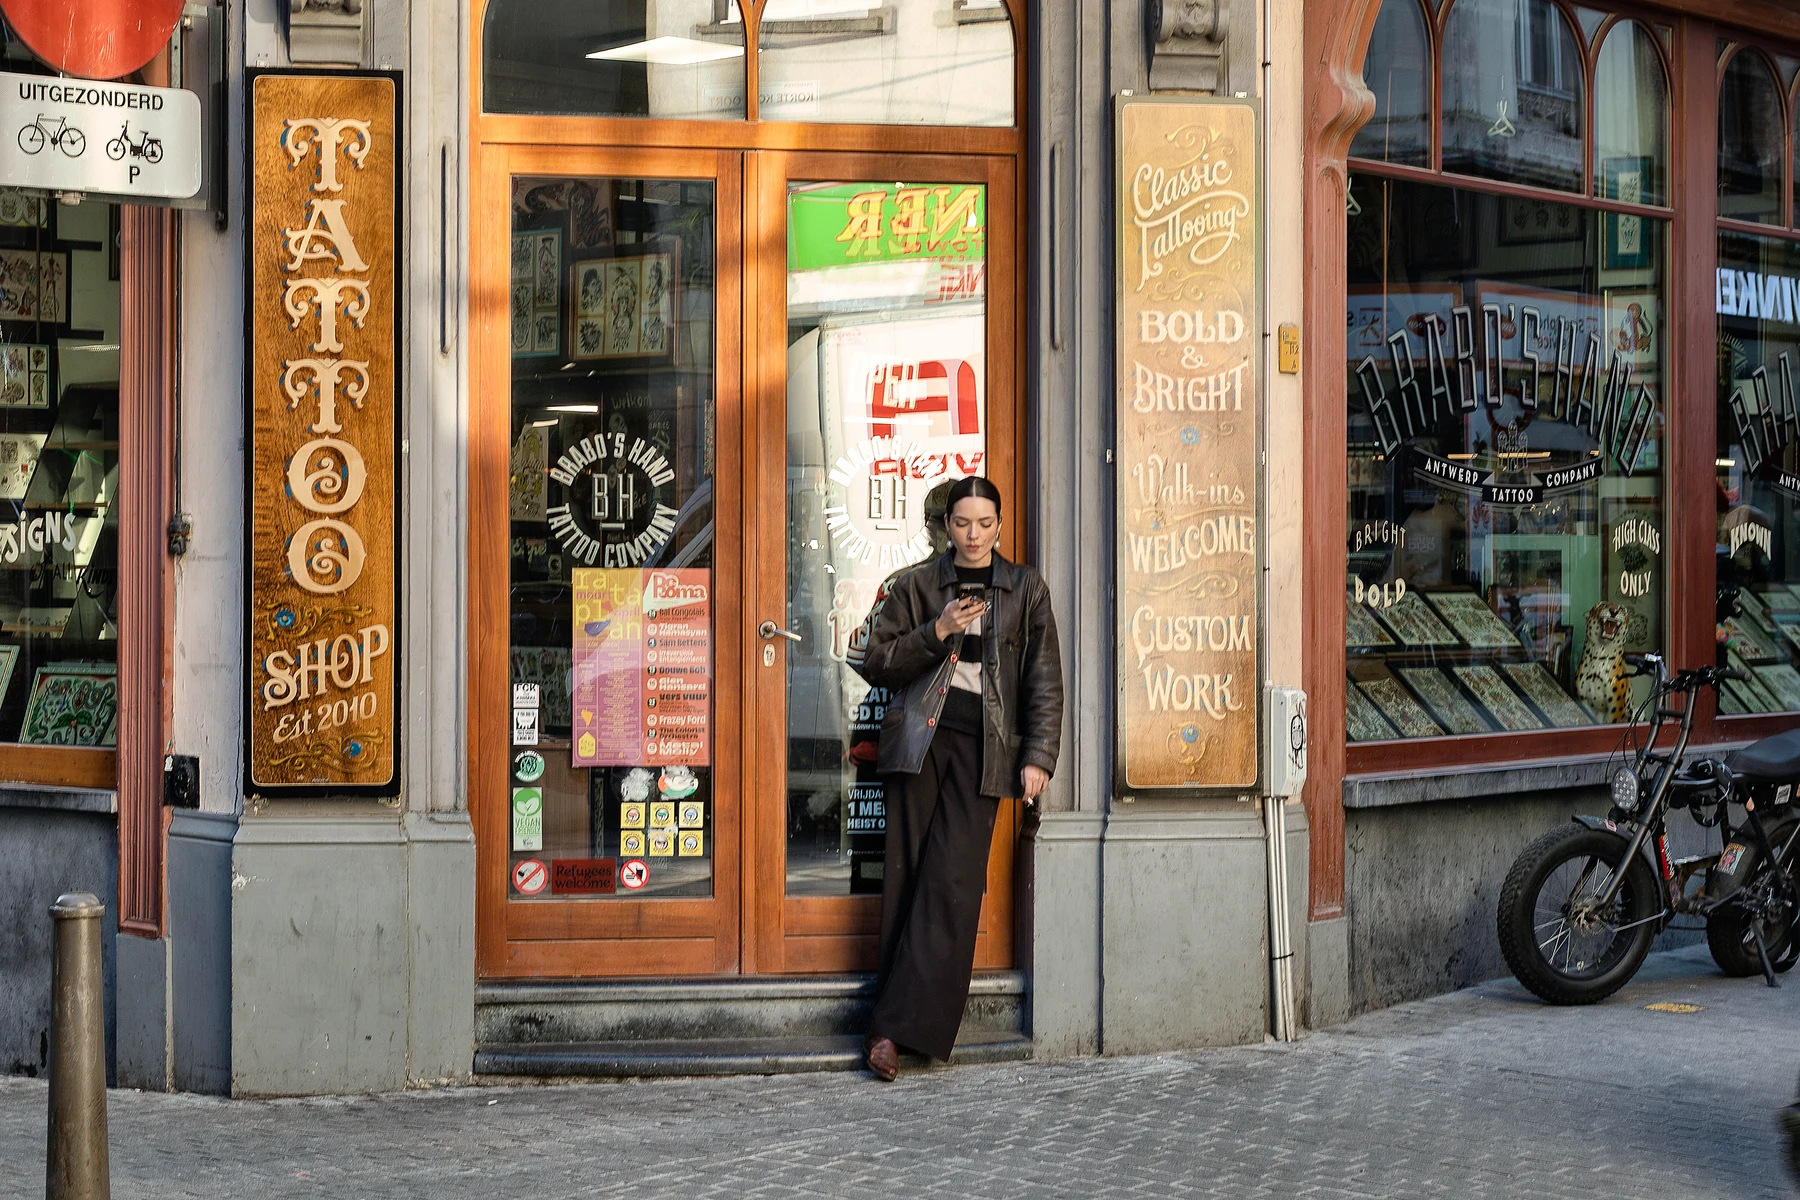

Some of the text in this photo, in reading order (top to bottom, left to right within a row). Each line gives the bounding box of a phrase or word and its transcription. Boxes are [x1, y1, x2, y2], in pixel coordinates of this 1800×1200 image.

[19, 83, 164, 110] UITGEZONDERD
[128, 166, 141, 185] P
[1133, 153, 1233, 219] Classic
[1140, 308, 1244, 344] BOLD
[284, 116, 373, 594] TATTOO
[1180, 344, 1209, 369] &
[1133, 359, 1249, 413] BRIGHT
[1355, 302, 1656, 477] BRABO'S HAND
[550, 432, 675, 488] BRABO'S HAND
[1424, 457, 1479, 486] ANTWERP
[1546, 462, 1596, 488] COMPANY
[592, 473, 634, 520] BH
[1132, 453, 1246, 506] Walk-ins
[1491, 487, 1534, 503] TATTOO
[546, 503, 679, 569] TATTOO COMPANY
[879, 526, 935, 569] COMP
[1128, 515, 1255, 575] WELCOME
[1356, 520, 1407, 553] BRIGHT
[1612, 518, 1660, 555] HIGH CLASS
[1730, 521, 1772, 562] KNOWN
[1354, 575, 1406, 609] BOLD
[1620, 570, 1652, 598] ONLY
[1130, 604, 1253, 669] CUSTOM
[263, 624, 389, 711] SHOP
[316, 692, 377, 734] 2010
[659, 714, 706, 726] Frazey Ford
[848, 704, 871, 721] CD
[515, 817, 541, 828] VEGAN
[847, 801, 856, 817] 1
[847, 817, 877, 829] HEIST
[556, 863, 612, 879] Refugees
